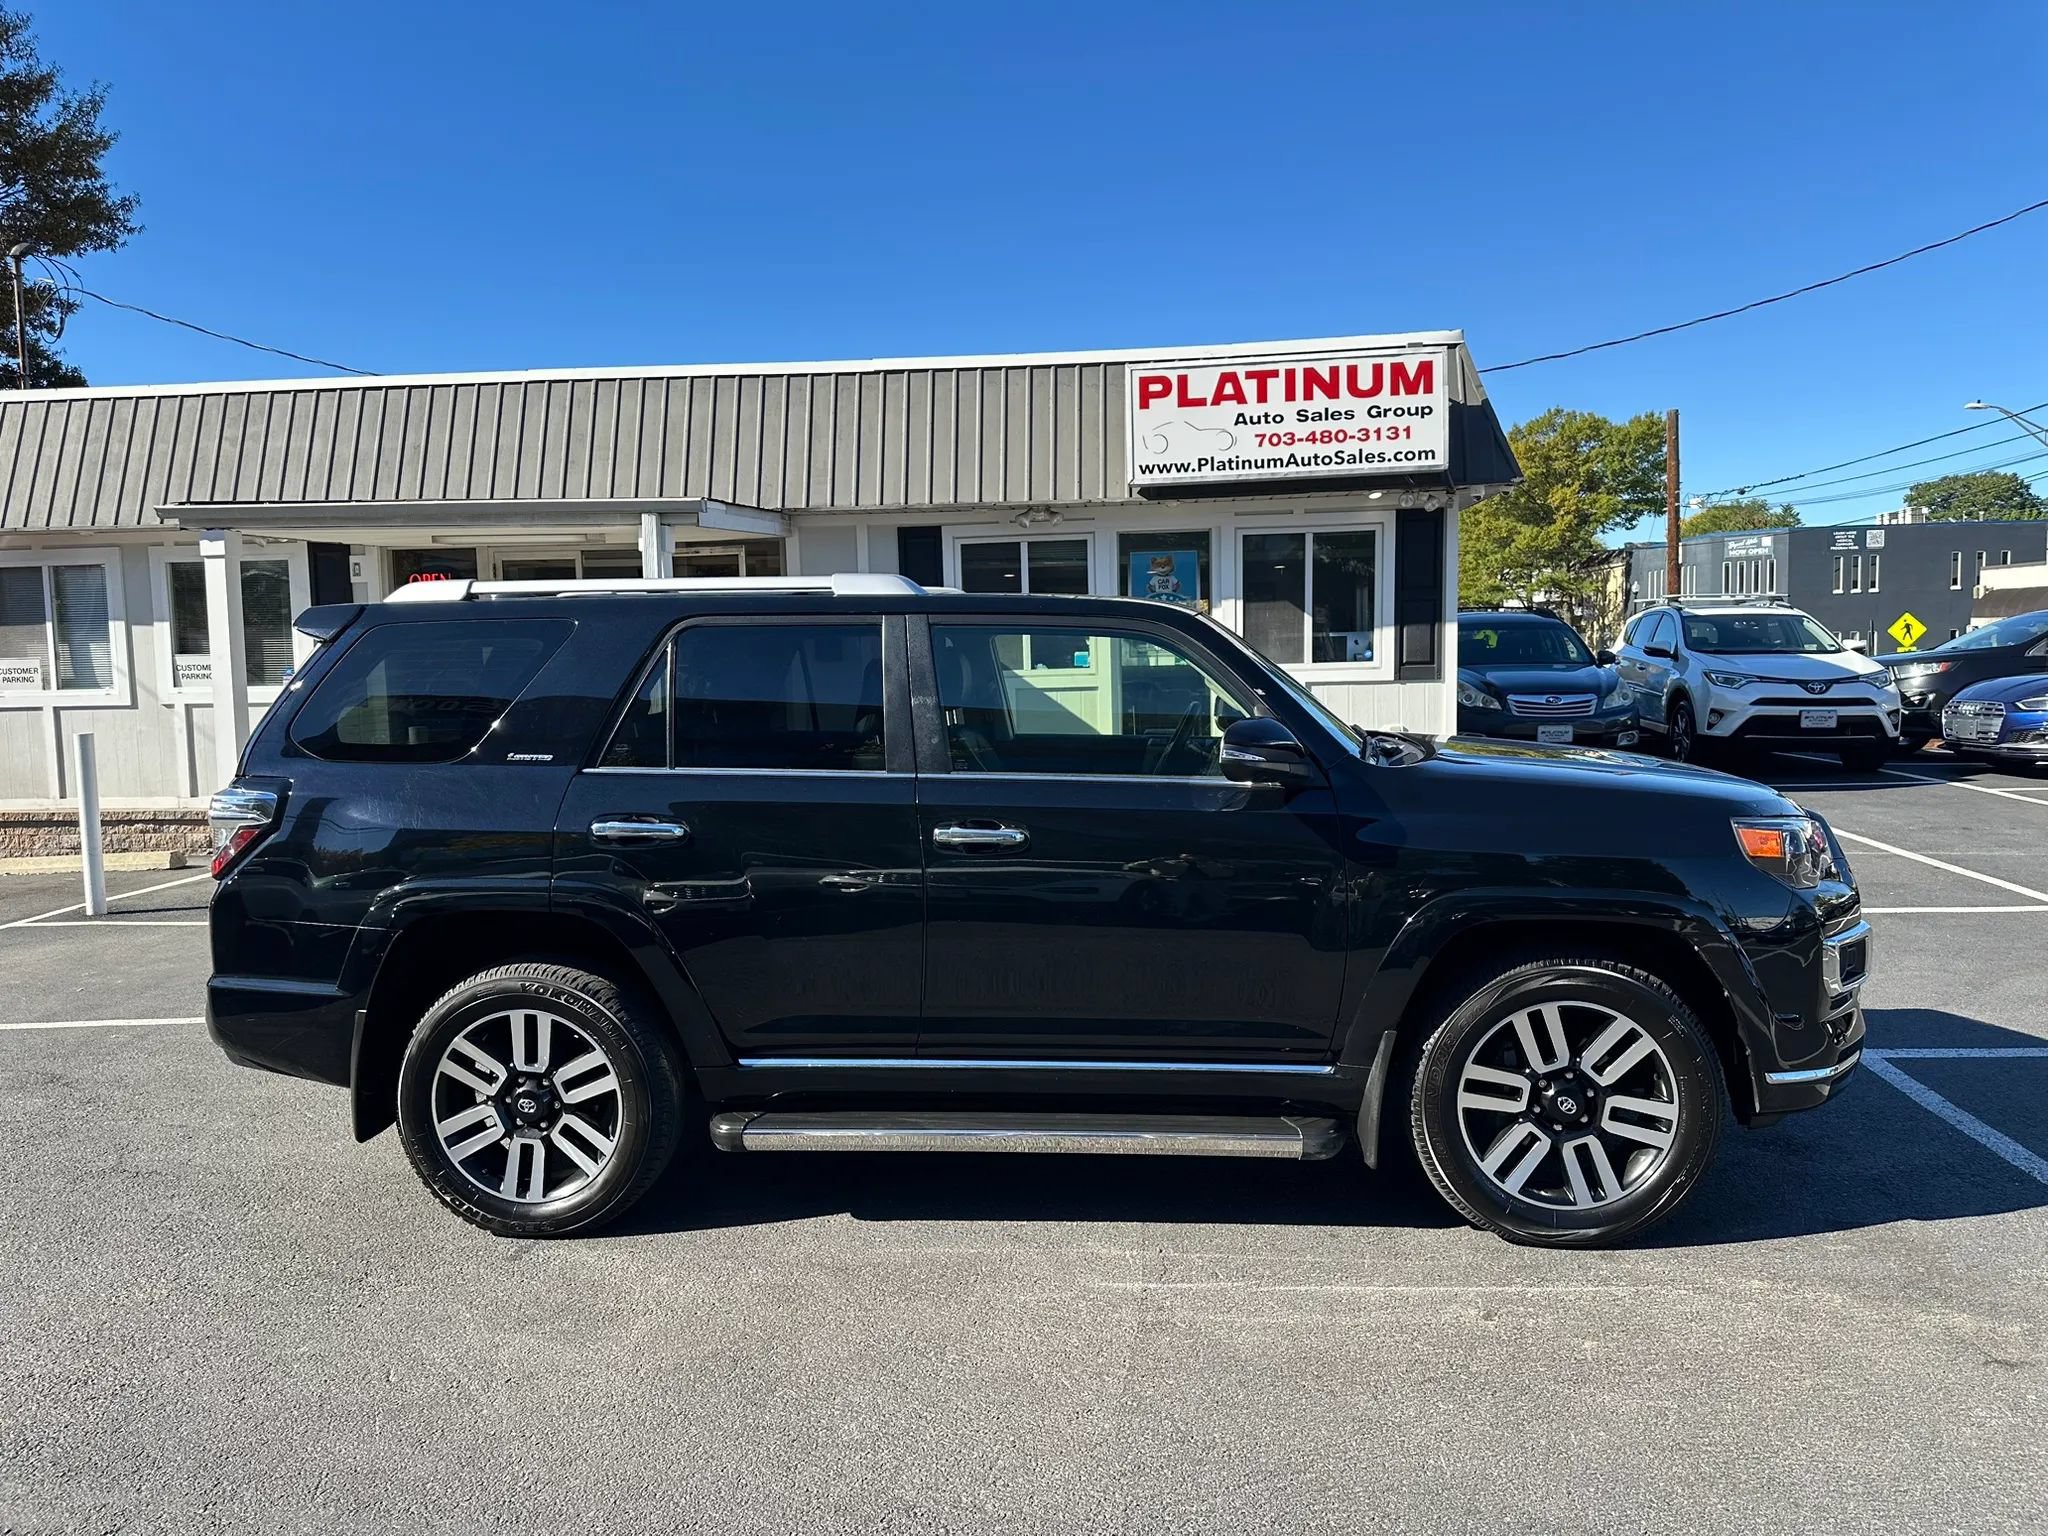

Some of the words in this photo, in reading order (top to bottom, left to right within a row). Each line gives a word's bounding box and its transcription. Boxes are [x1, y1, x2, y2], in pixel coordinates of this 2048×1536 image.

[1138, 360, 1434, 410] PLATINUM
[1233, 412, 1285, 426] Auto
[1296, 408, 1355, 423] Sales
[1366, 404, 1434, 420] Group
[1254, 425, 1412, 448] 703-480-3131
[1139, 448, 1436, 475] www.PlatinumAutoSales.com
